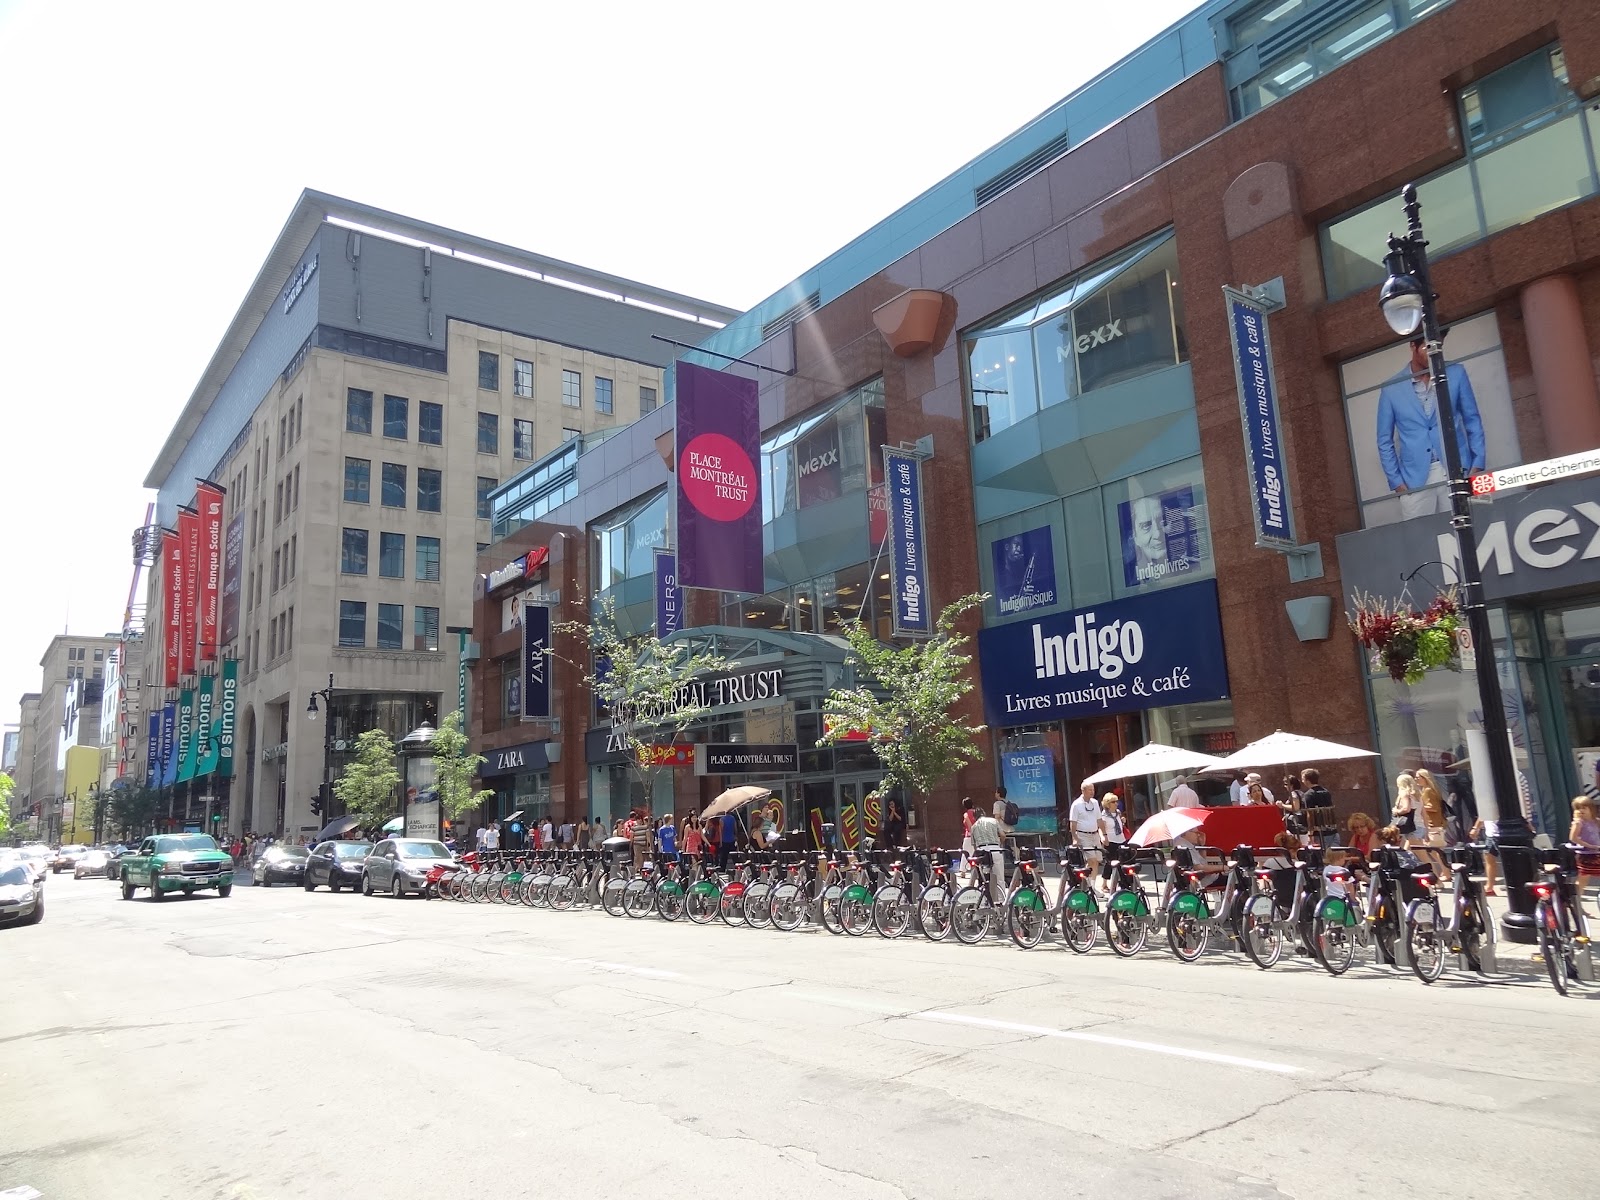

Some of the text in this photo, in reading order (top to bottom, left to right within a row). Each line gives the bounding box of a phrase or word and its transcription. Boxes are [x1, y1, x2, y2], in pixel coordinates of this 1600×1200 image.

[1243, 315, 1259, 344] café
[1248, 347, 1260, 357] &
[1252, 360, 1269, 416] musique
[1261, 419, 1275, 459] Livres
[689, 451, 722, 469] PLACE
[898, 463, 910, 485] café
[690, 466, 748, 488] MONTRÉAL
[900, 487, 911, 496] &
[714, 484, 748, 502] TRUST
[902, 497, 915, 540] musique
[209, 520, 220, 549] Scotia
[187, 527, 198, 607] DIVERTISSEMENT
[208, 550, 220, 590] Banque
[905, 541, 917, 571] Livres
[171, 590, 181, 626] Banque
[532, 637, 544, 684] ZARA
[714, 669, 783, 706] TRUST
[1005, 666, 1191, 713] Livres musique & café
[497, 750, 524, 770] ZARA
[710, 752, 794, 765] PLACE MONTRÉAL TRUST
[1010, 754, 1046, 767] SOLDES
